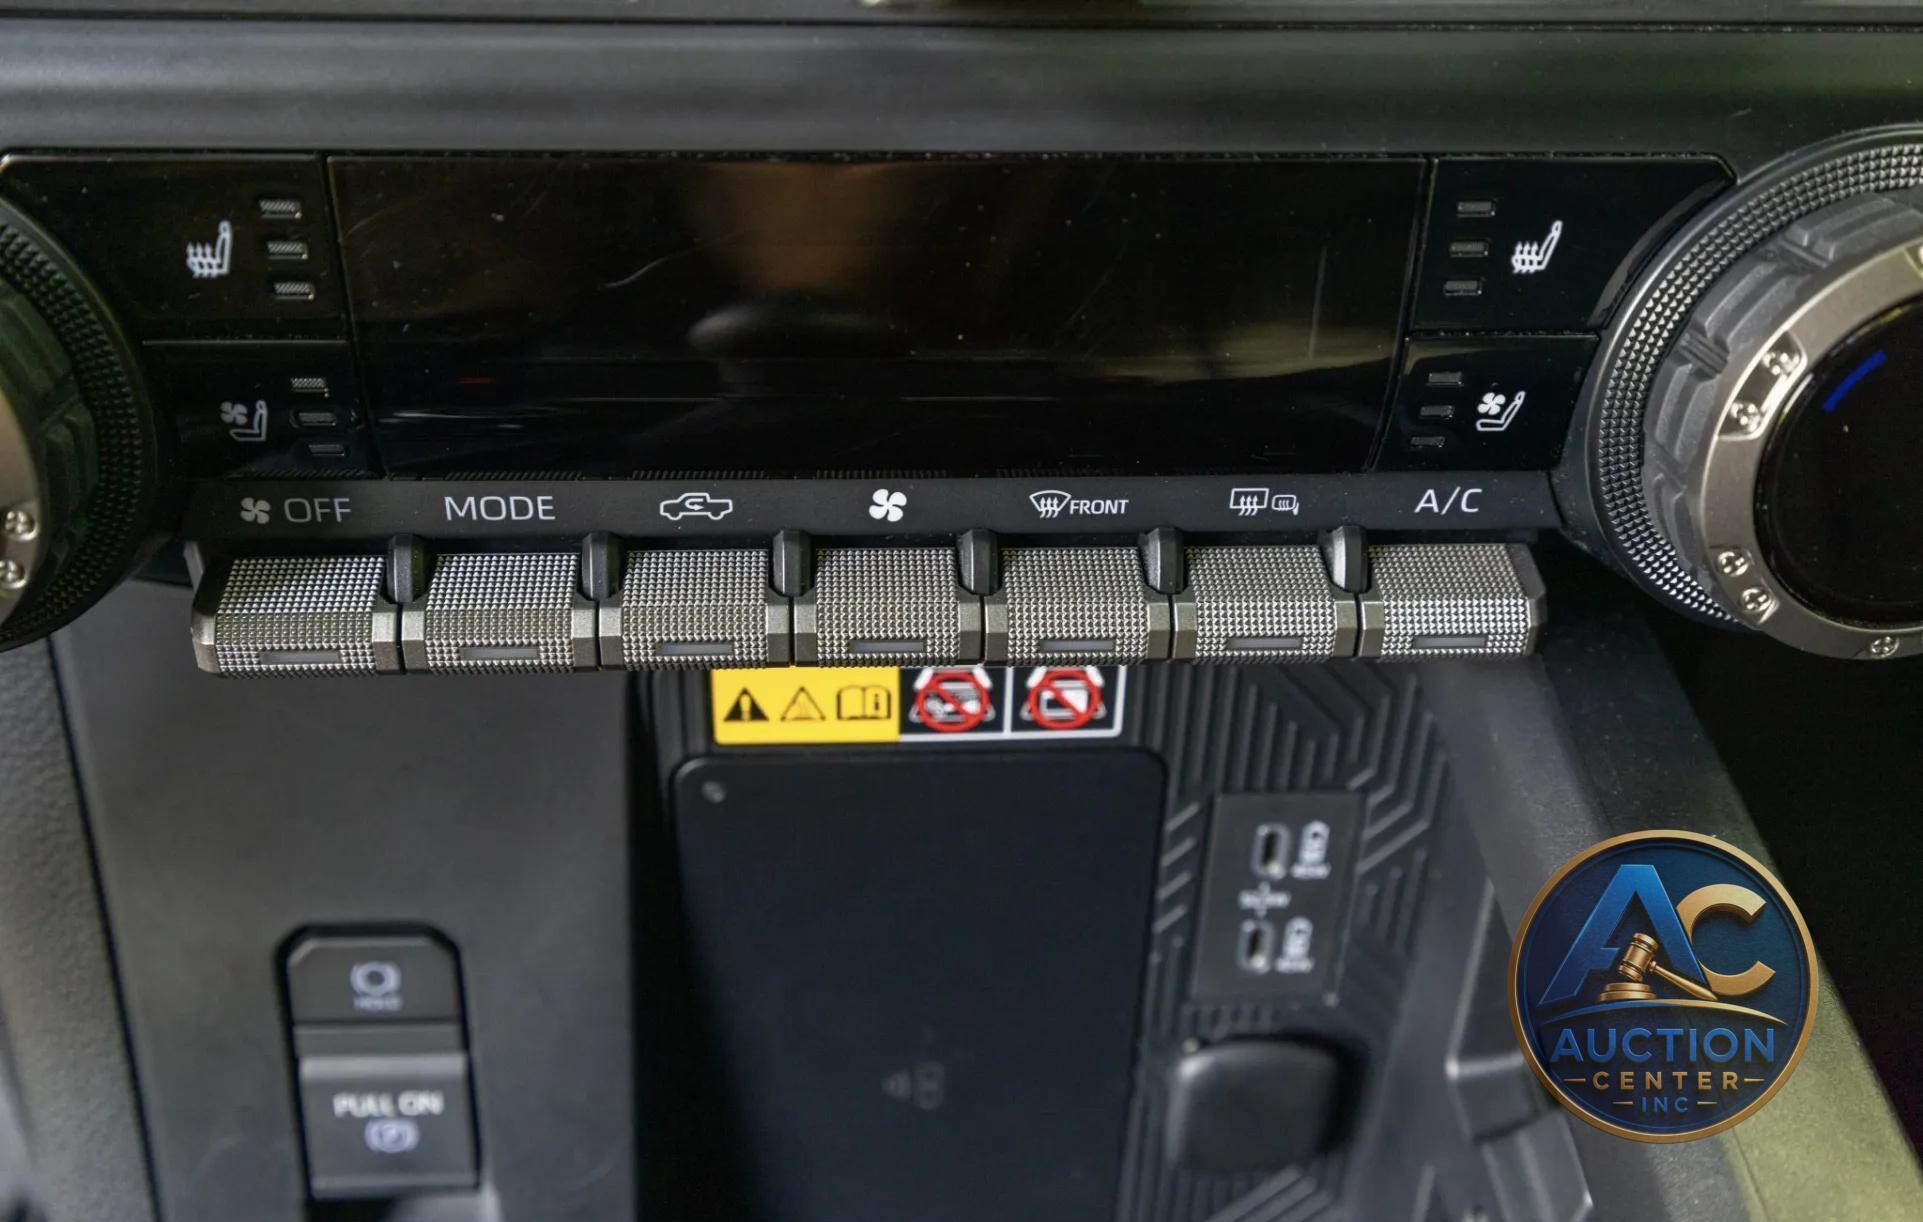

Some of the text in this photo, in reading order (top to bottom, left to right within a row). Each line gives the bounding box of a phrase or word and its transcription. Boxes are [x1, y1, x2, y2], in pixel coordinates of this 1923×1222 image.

[283, 497, 351, 523] OFF
[444, 495, 556, 521] MODE
[1069, 499, 1129, 516] FRONT
[1414, 486, 1483, 514] A/C
[332, 1089, 445, 1118] PULL ON
